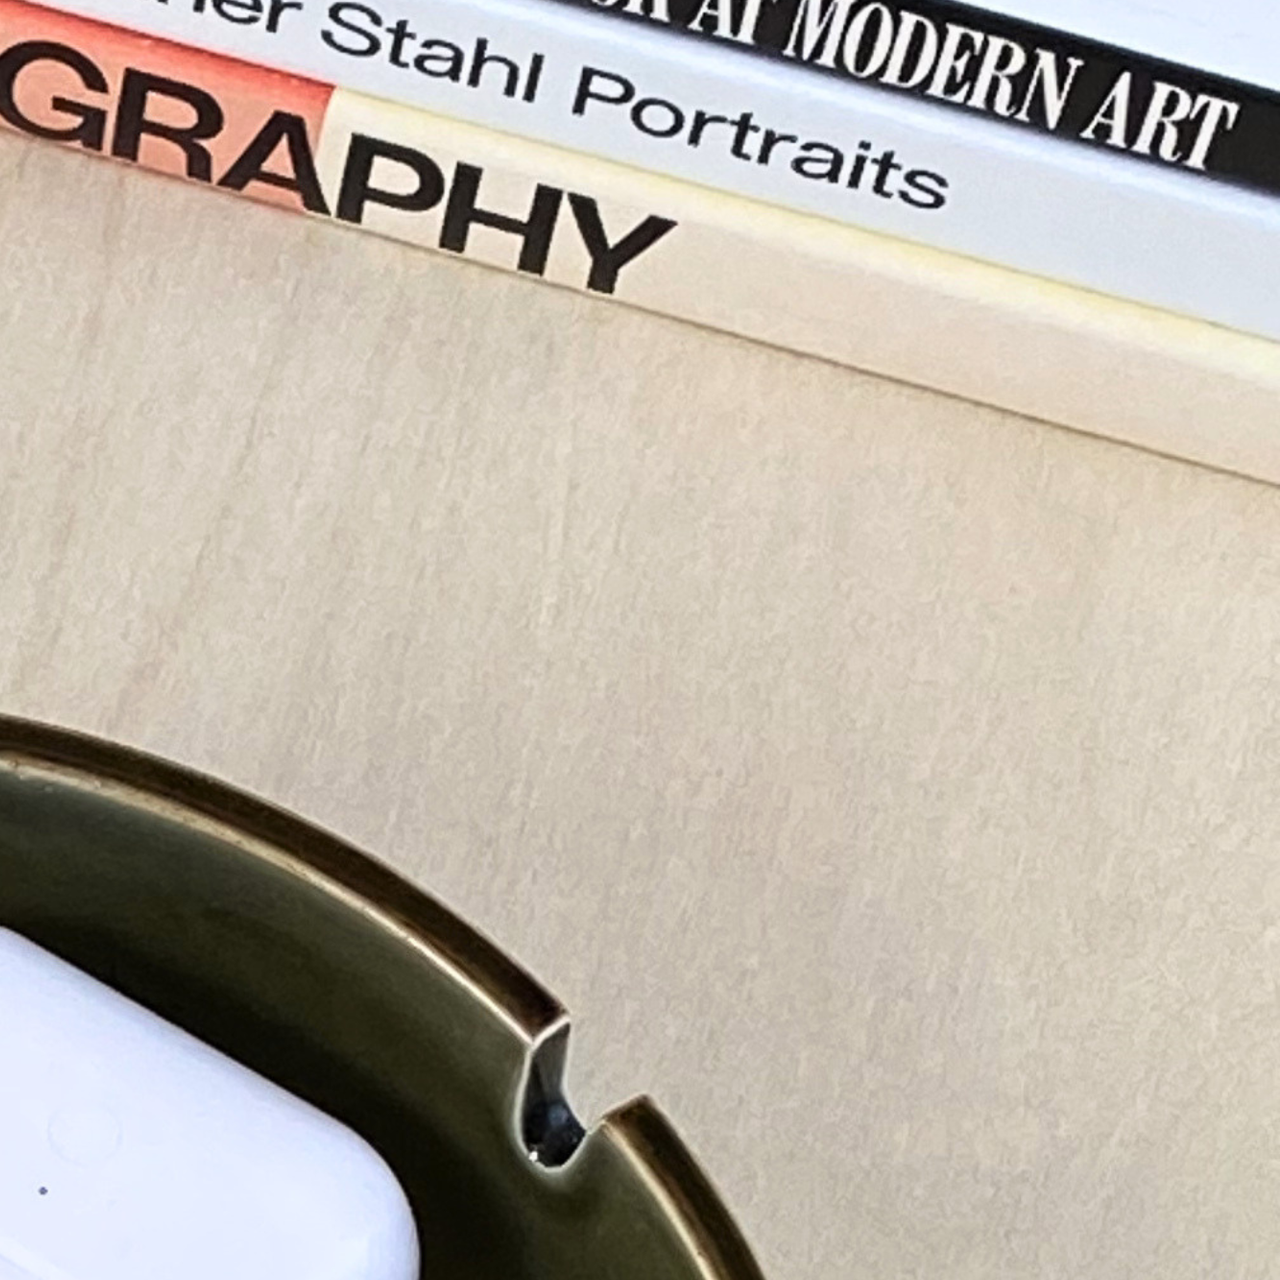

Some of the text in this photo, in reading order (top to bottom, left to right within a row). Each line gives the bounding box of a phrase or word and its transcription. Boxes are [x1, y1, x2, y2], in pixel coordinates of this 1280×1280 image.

[320, 1, 545, 105] Stahl
[571, 65, 951, 211] Portraits
[783, 0, 1085, 132] MODERN
[1080, 71, 1240, 172] ART
